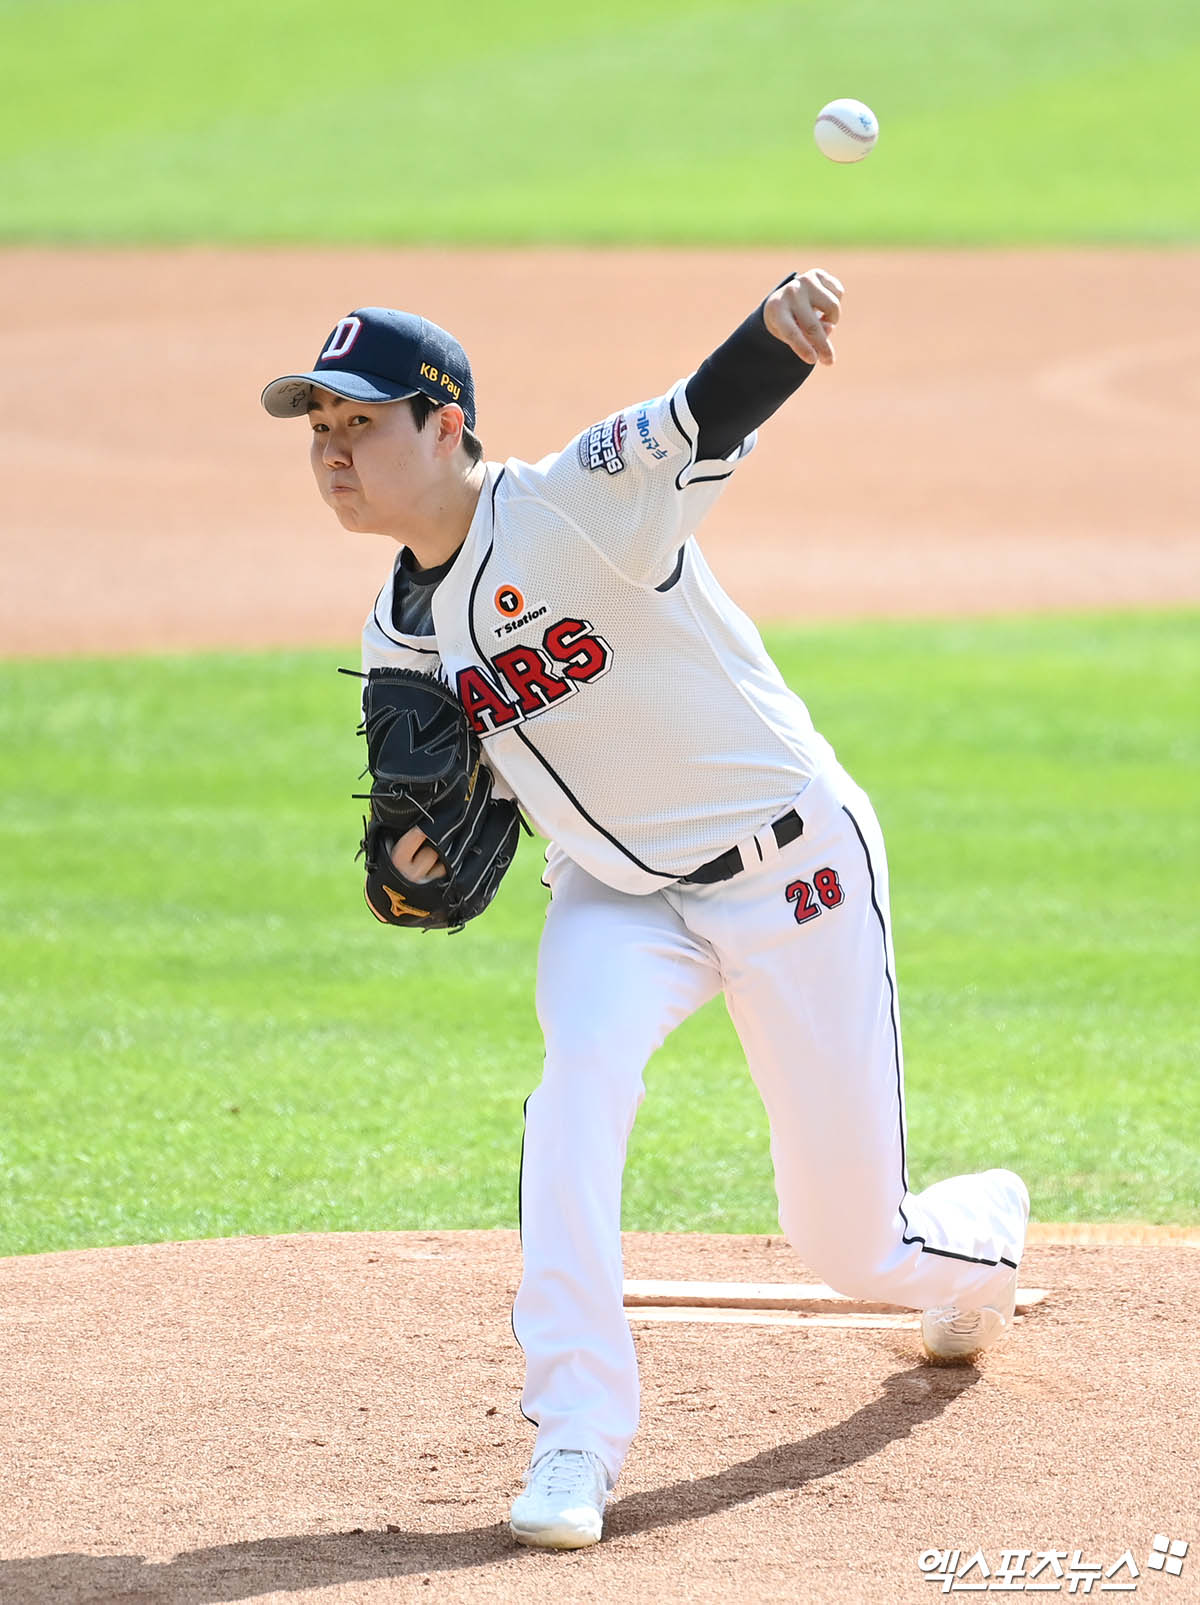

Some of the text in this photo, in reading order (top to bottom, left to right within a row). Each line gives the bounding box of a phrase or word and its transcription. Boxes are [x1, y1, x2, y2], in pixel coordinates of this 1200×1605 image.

[321, 316, 364, 362] D
[420, 362, 461, 400] KB Pay
[785, 867, 845, 925] 28
